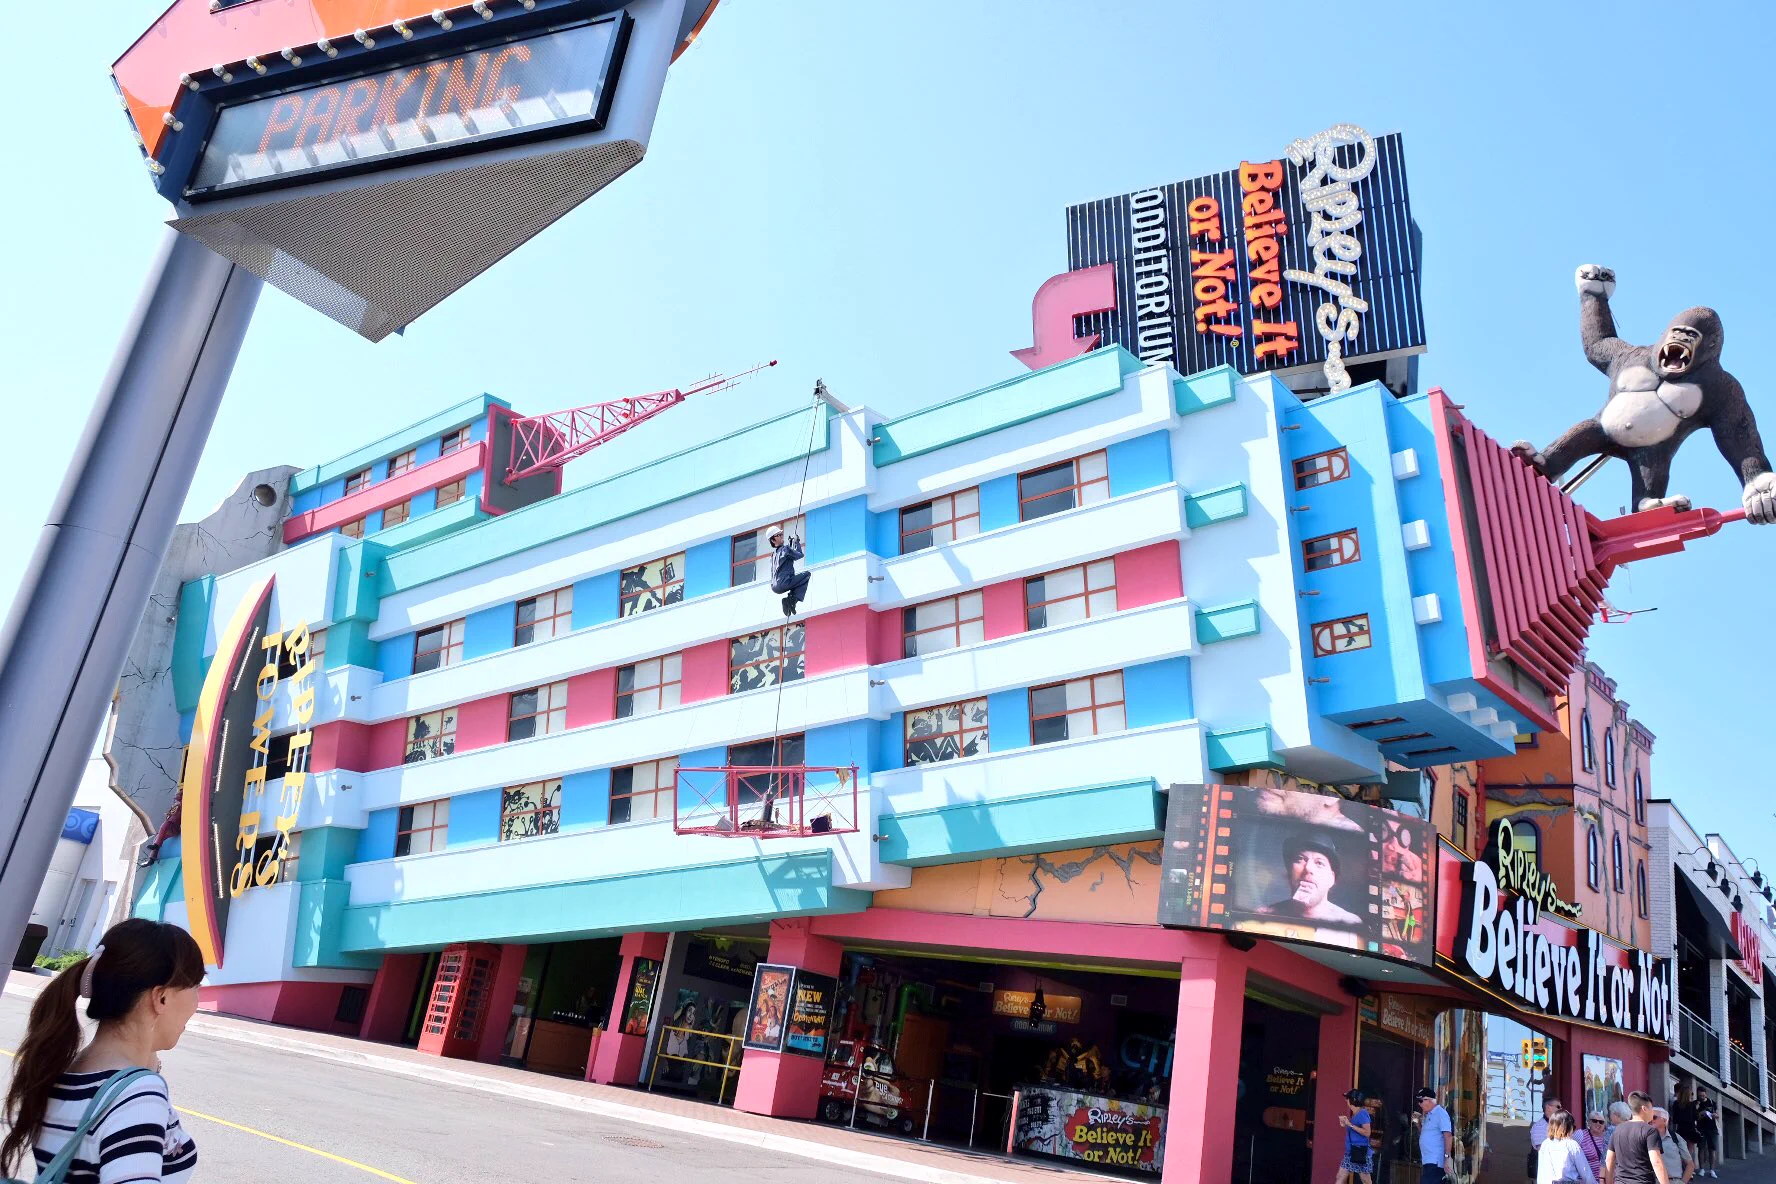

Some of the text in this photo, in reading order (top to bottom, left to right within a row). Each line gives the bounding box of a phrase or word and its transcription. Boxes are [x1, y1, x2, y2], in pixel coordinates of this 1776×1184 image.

[252, 45, 531, 166] PARKING
[1130, 189, 1175, 370] ODDITORIUM
[1188, 196, 1243, 338] or Not!
[1239, 160, 1299, 361] Believe It
[1283, 123, 1376, 393] Ripley's
[230, 622, 284, 898] TOWERS
[256, 618, 316, 889] RIPLEY'S
[798, 989, 822, 1003] NEW
[994, 1001, 1029, 1015] Believe
[1055, 1007, 1079, 1020] Not!
[1466, 860, 1582, 1017] Believe
[1585, 928, 1607, 1024] It
[1611, 965, 1634, 1029] or
[1073, 1125, 1153, 1147] Believe It
[1083, 1147, 1142, 1165] or Not!
